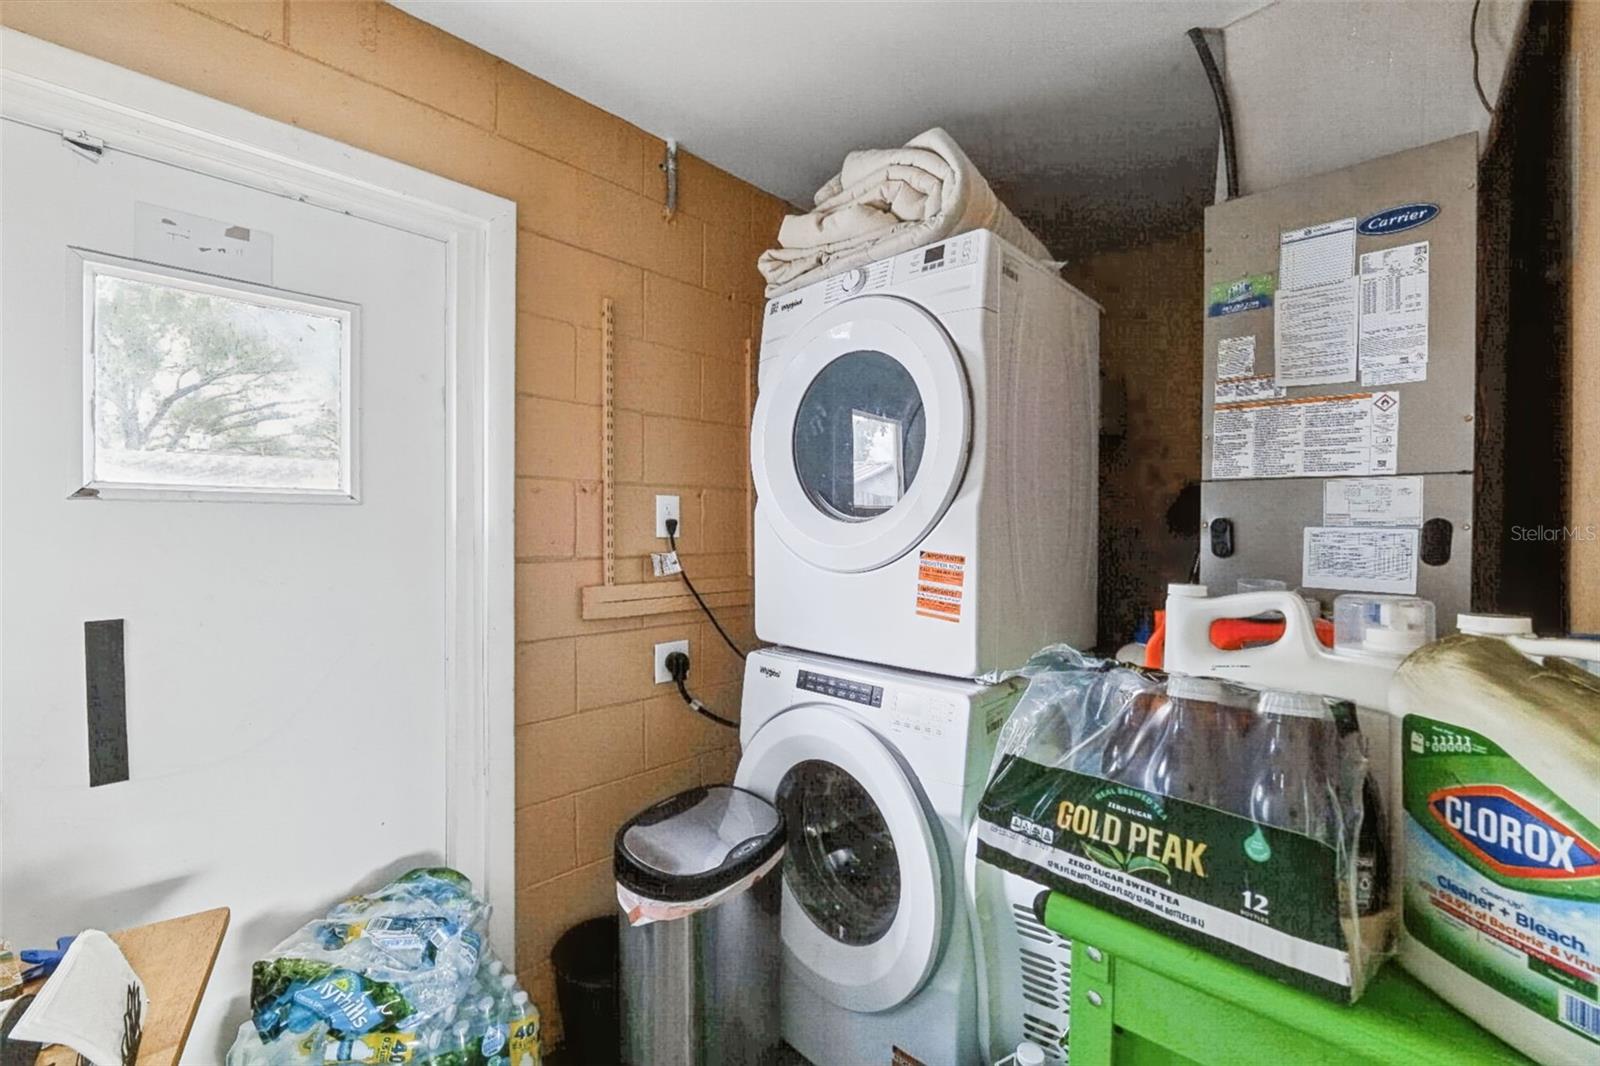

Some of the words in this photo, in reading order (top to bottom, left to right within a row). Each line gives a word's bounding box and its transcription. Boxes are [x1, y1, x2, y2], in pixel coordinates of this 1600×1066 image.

[1367, 209, 1428, 230] Carrier
[1107, 801, 1127, 813] ZERO
[1127, 808, 1153, 820] SUGAR
[1056, 800, 1122, 846] GOLD
[1128, 821, 1208, 878] PEAK
[1444, 795, 1576, 873] CLOROX
[1068, 858, 1091, 870] ZERO
[1093, 867, 1125, 884] SUGAR
[1126, 880, 1157, 897] SWEET
[1160, 892, 1180, 907] TEA
[1241, 890, 1269, 915] 12
[1165, 907, 1190, 923] BOTTLES
[1437, 875, 1496, 912] Cleaner
[1500, 906, 1511, 917] +
[1515, 912, 1587, 954] Bleach
[1475, 910, 1487, 921] of
[514, 1021, 535, 1040] 40
